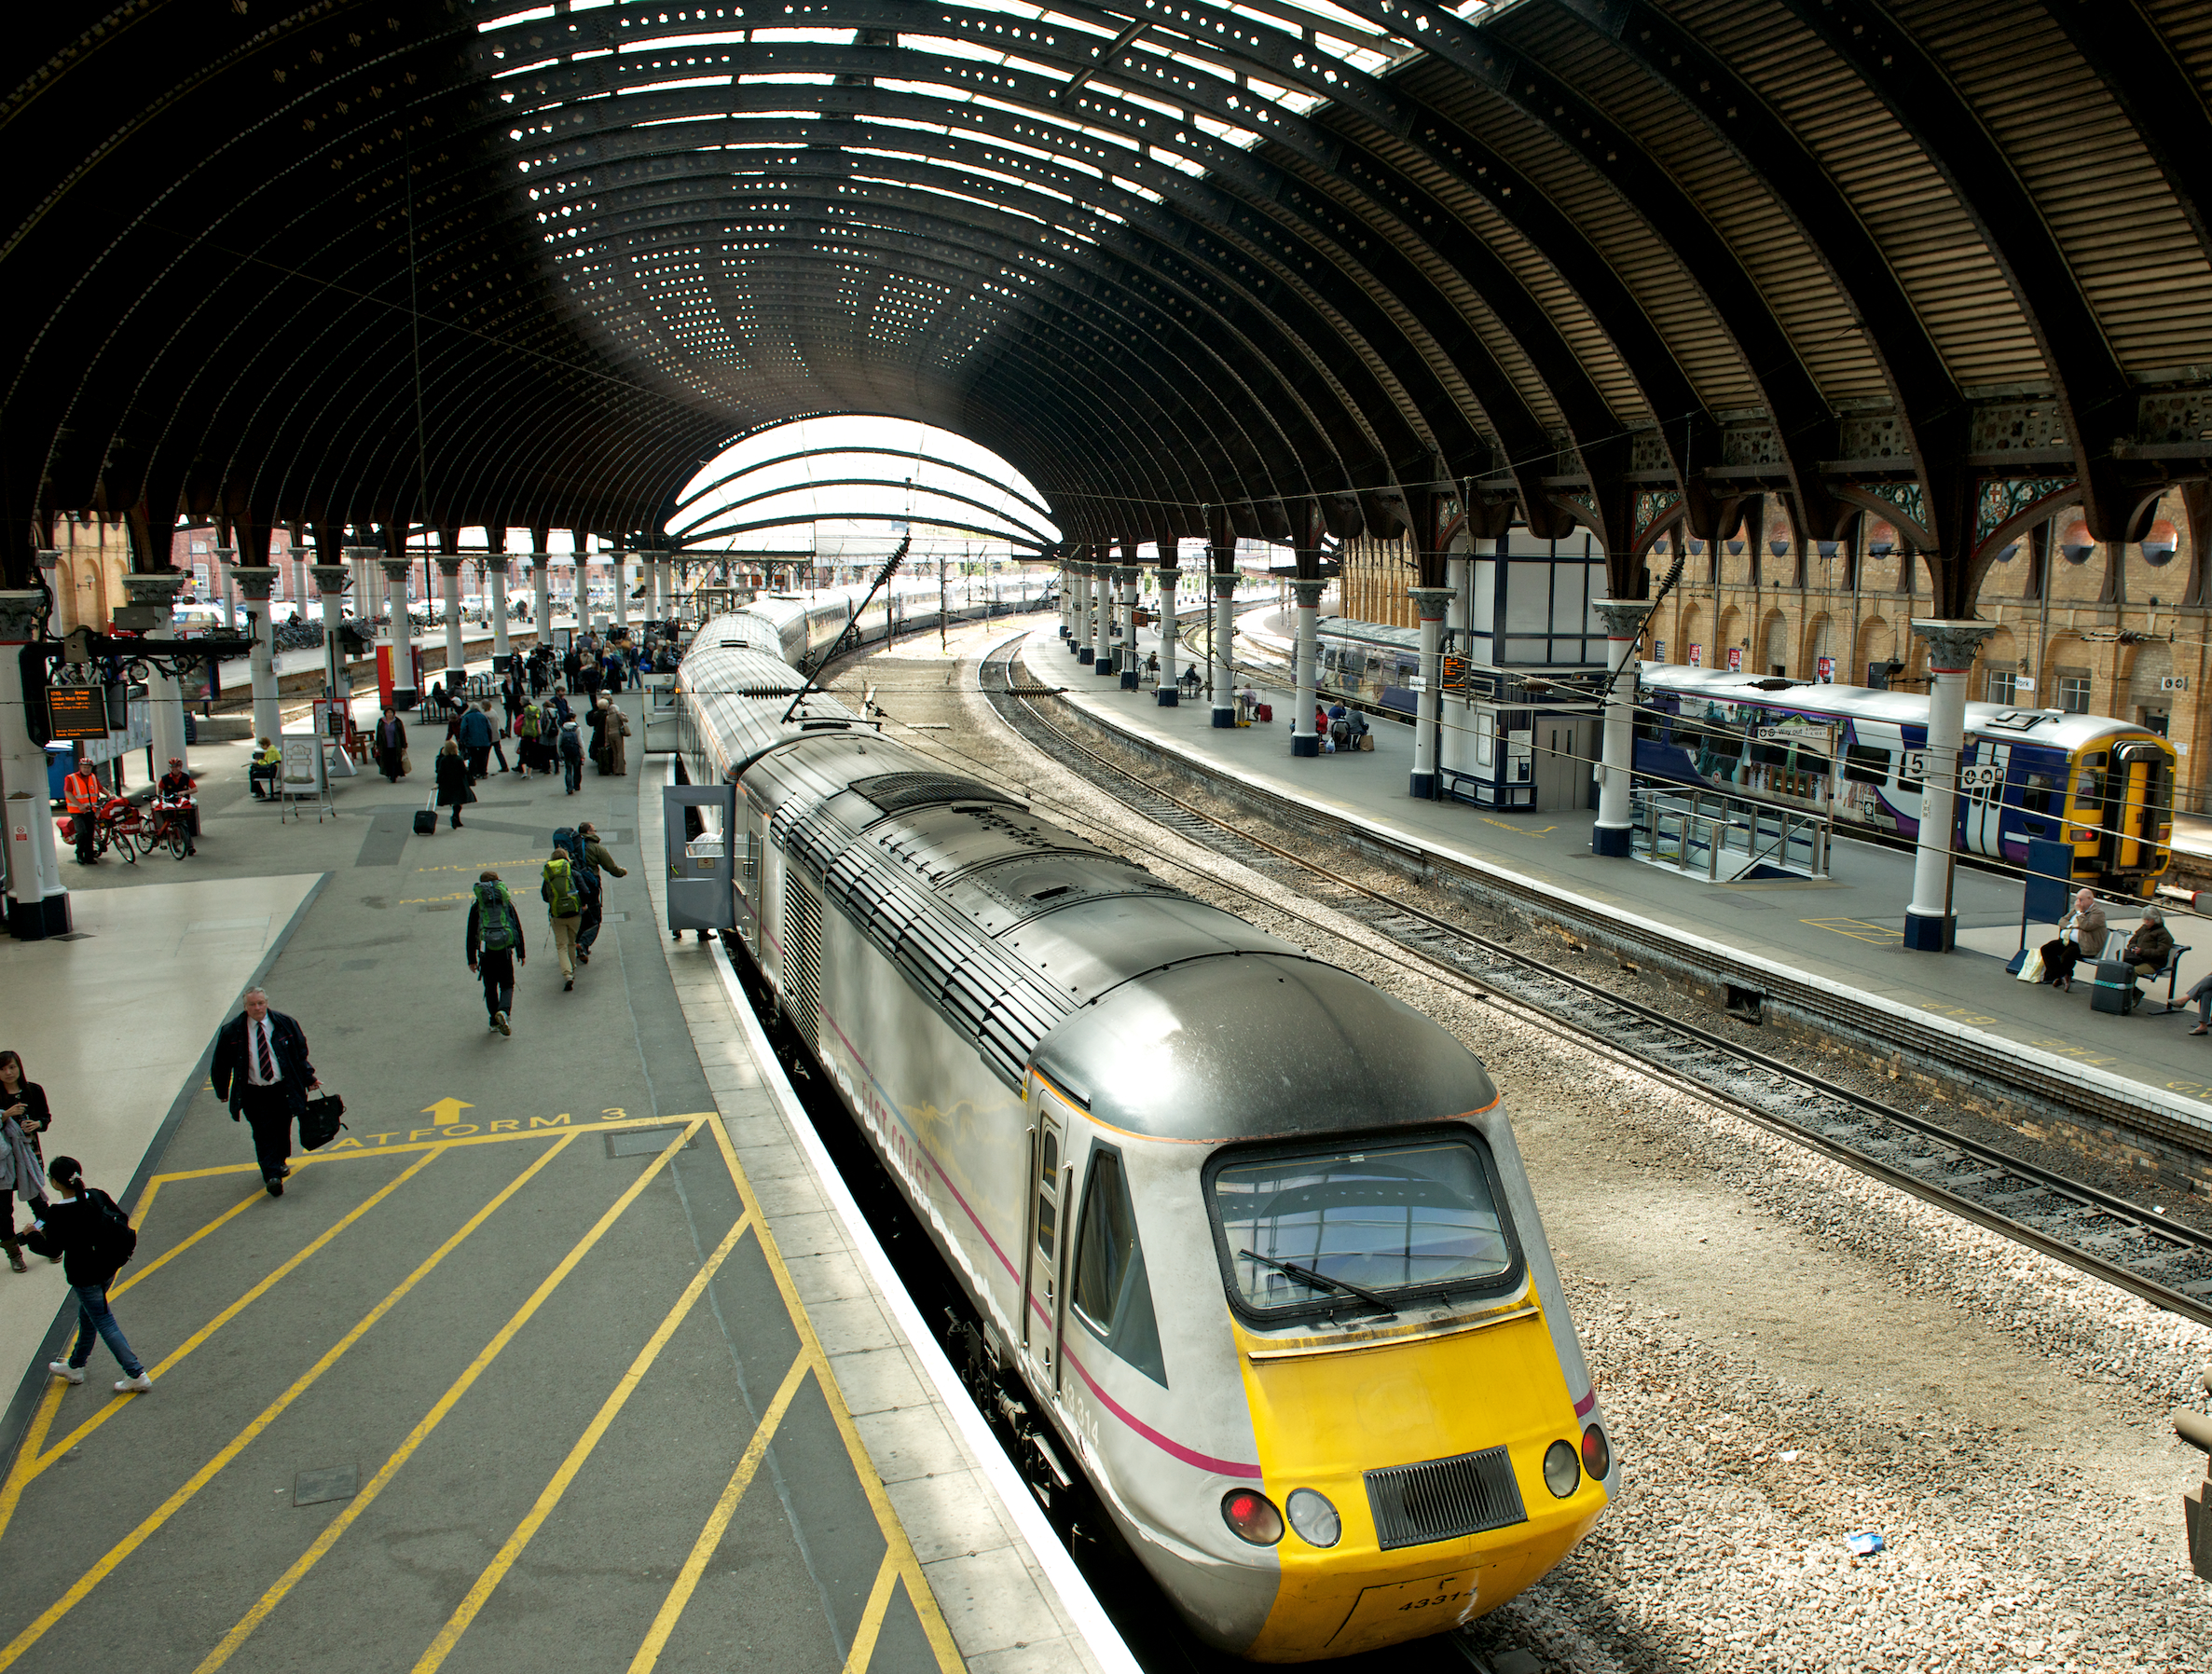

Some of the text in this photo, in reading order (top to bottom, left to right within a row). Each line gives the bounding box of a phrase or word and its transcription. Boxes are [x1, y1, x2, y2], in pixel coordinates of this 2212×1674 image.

[381, 626, 388, 637] 1
[413, 626, 421, 637] 3
[2015, 679, 2030, 688] York
[1911, 753, 1924, 774] 5
[1921, 1003, 1998, 1024] GAP
[2031, 1038, 2118, 1065] THE
[601, 1107, 627, 1119] 3
[861, 1080, 887, 1139] EAST
[892, 1124, 931, 1199] COAST
